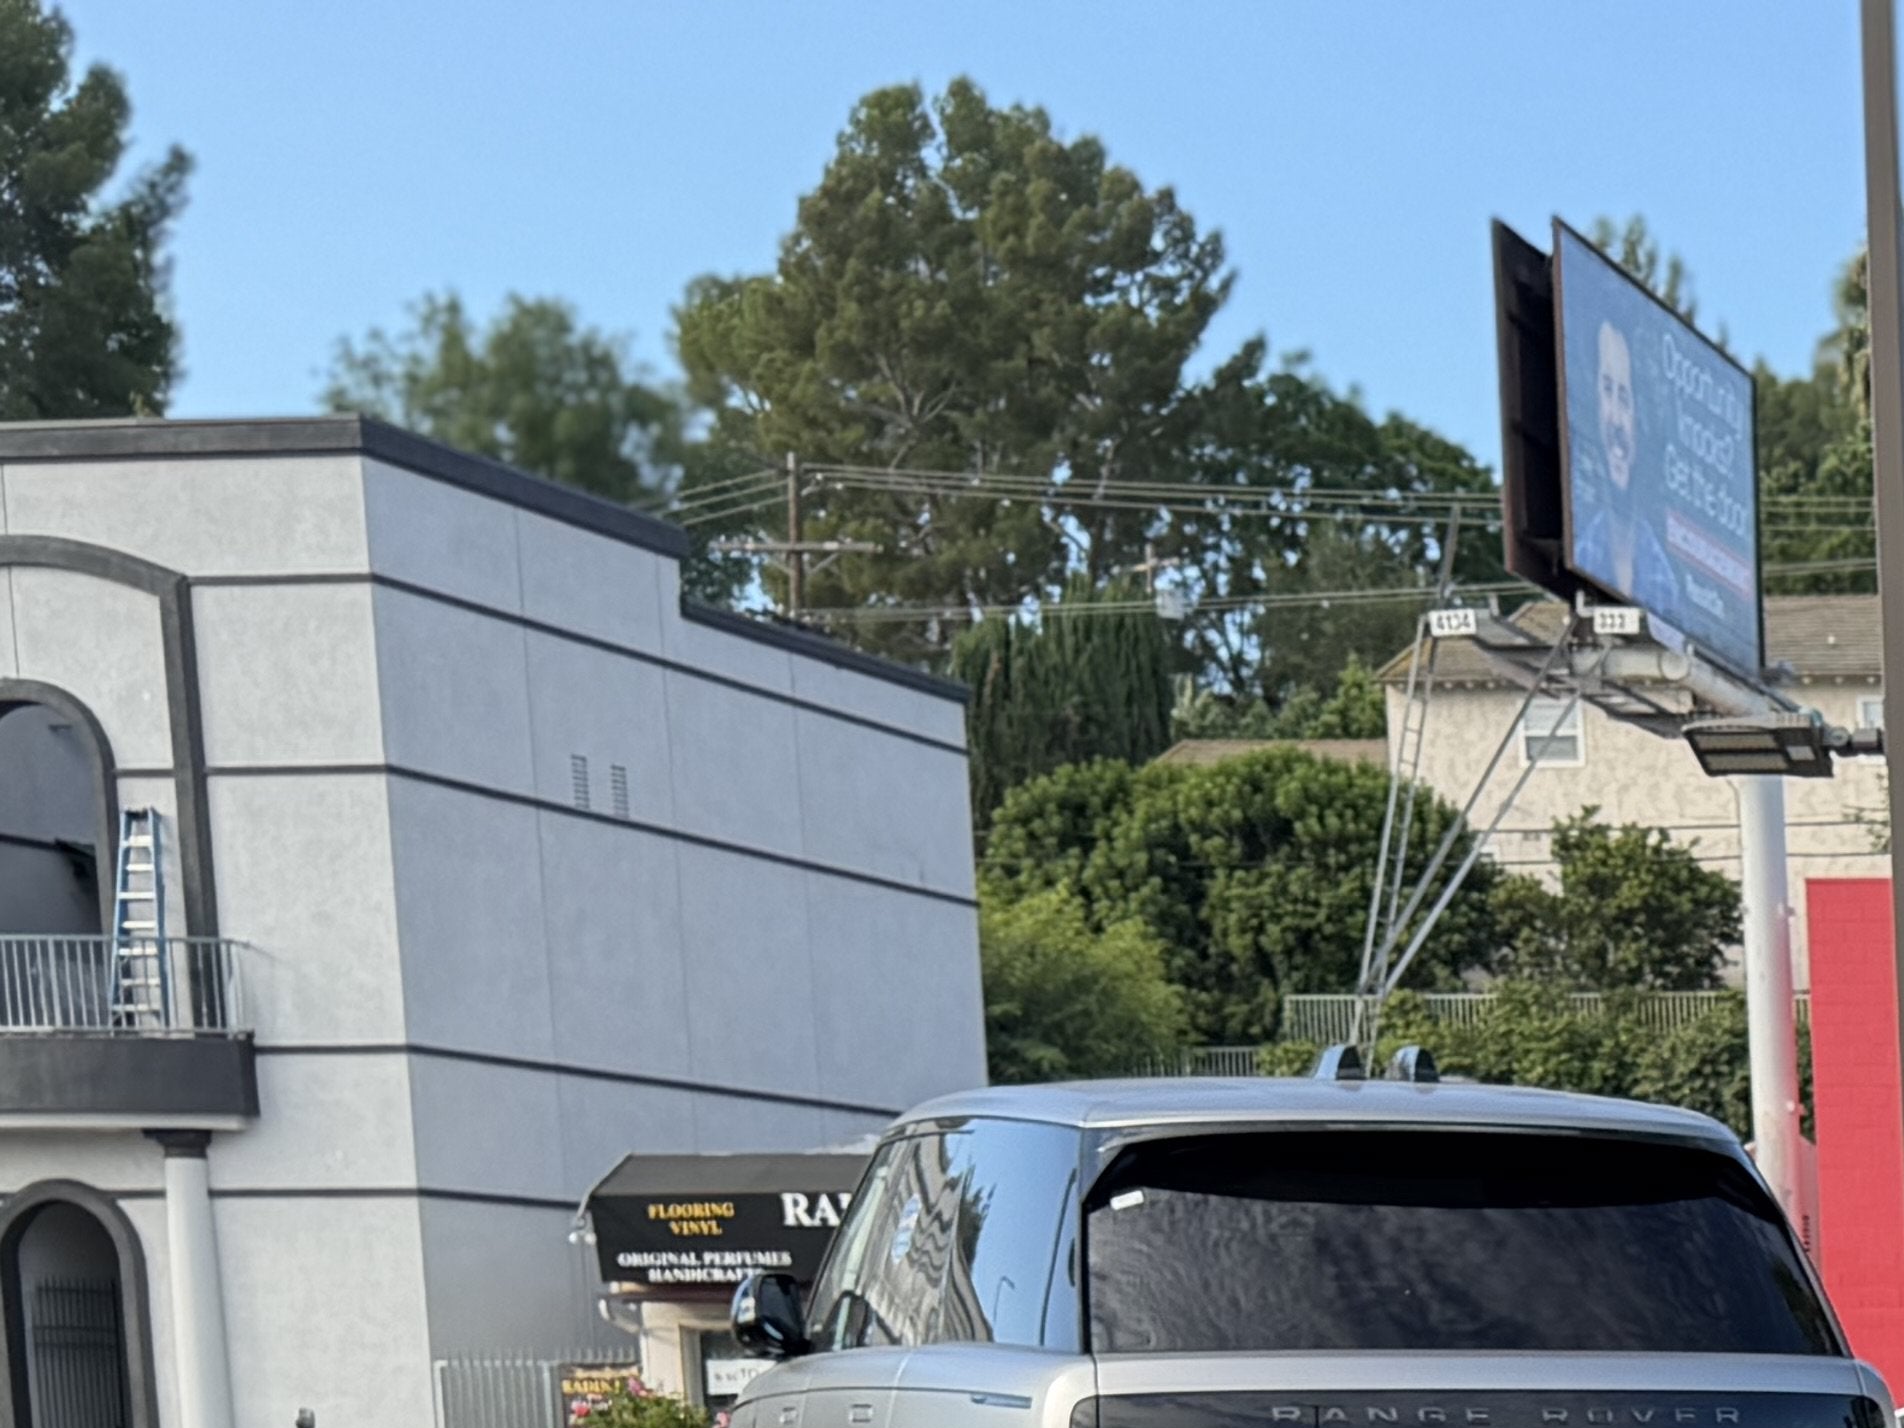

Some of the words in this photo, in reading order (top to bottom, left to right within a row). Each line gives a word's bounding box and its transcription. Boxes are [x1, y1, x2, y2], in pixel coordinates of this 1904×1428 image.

[648, 1202, 735, 1219] FLOORING
[669, 1221, 722, 1236] VINYL
[617, 1252, 699, 1267] ORIGINAL
[702, 1251, 793, 1267] PERFUMES
[1271, 1405, 1491, 1423] RANGE
[1542, 1405, 1740, 1423] ROVER
